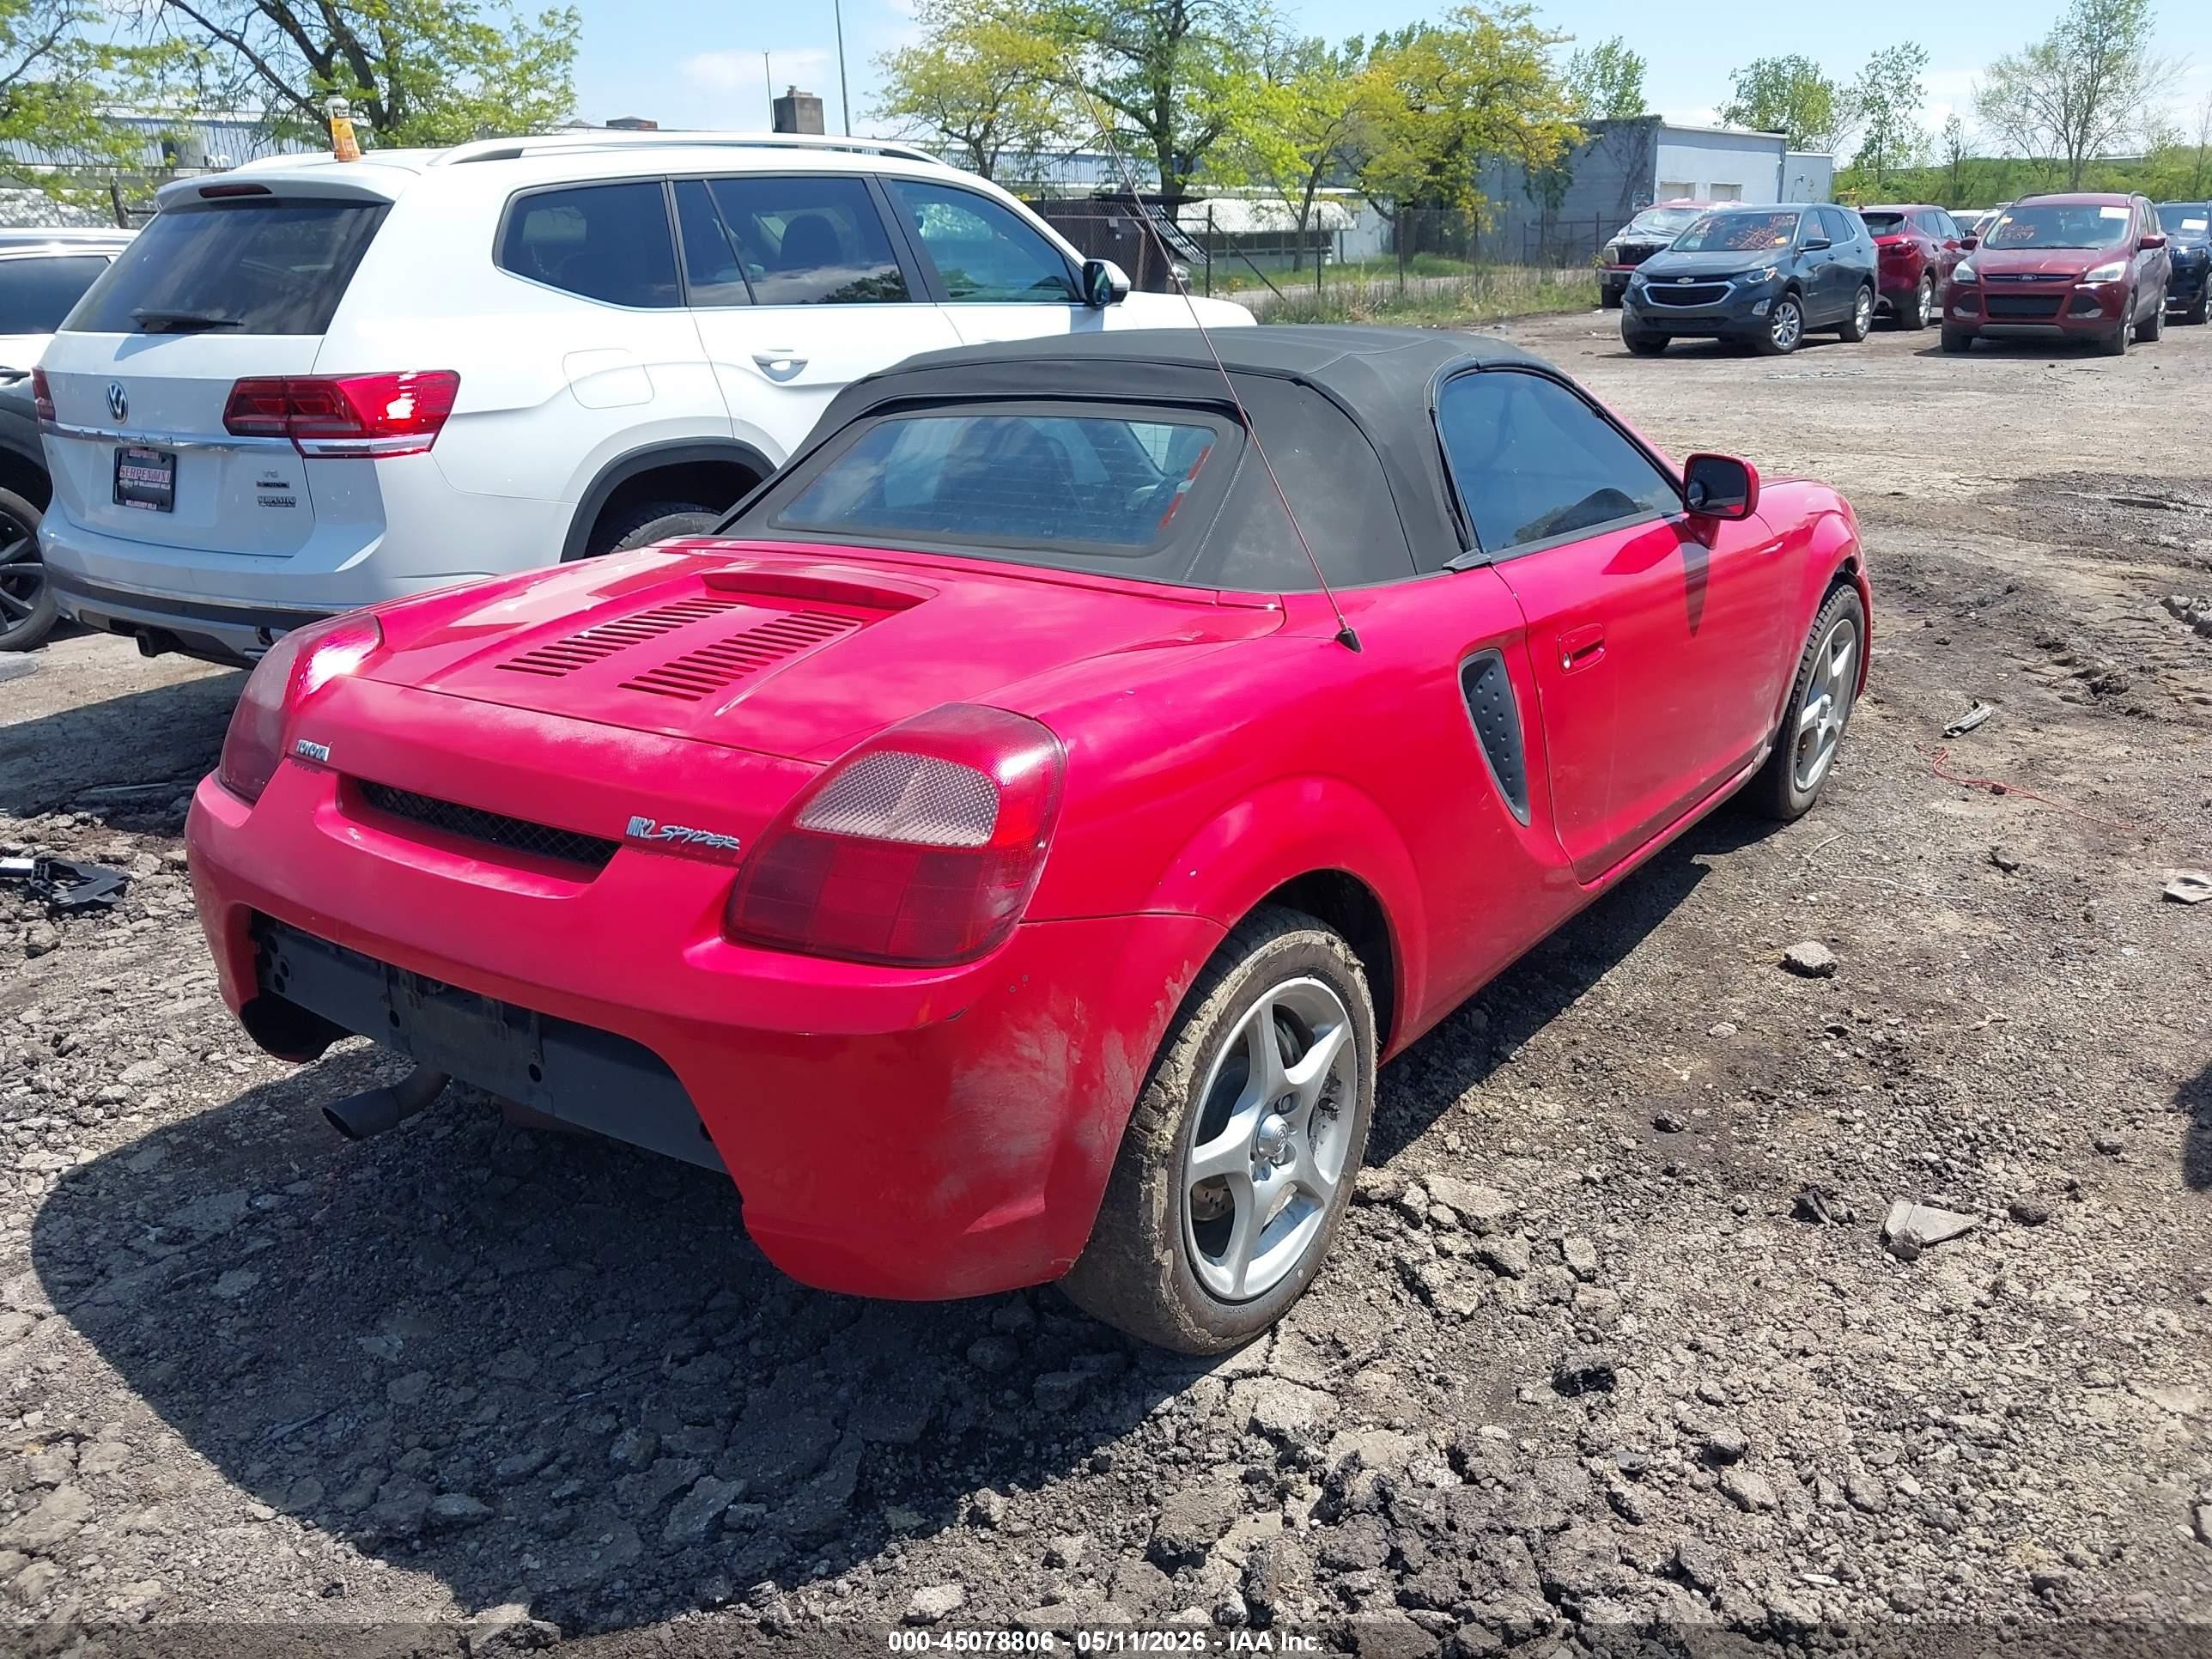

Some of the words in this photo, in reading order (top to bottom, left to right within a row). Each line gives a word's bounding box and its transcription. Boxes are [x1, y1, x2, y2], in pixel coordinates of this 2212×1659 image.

[119, 465, 172, 483] SERPENTINI
[295, 738, 331, 763] TOYOTA
[626, 816, 656, 839] MR2
[649, 824, 740, 850] SPYDER
